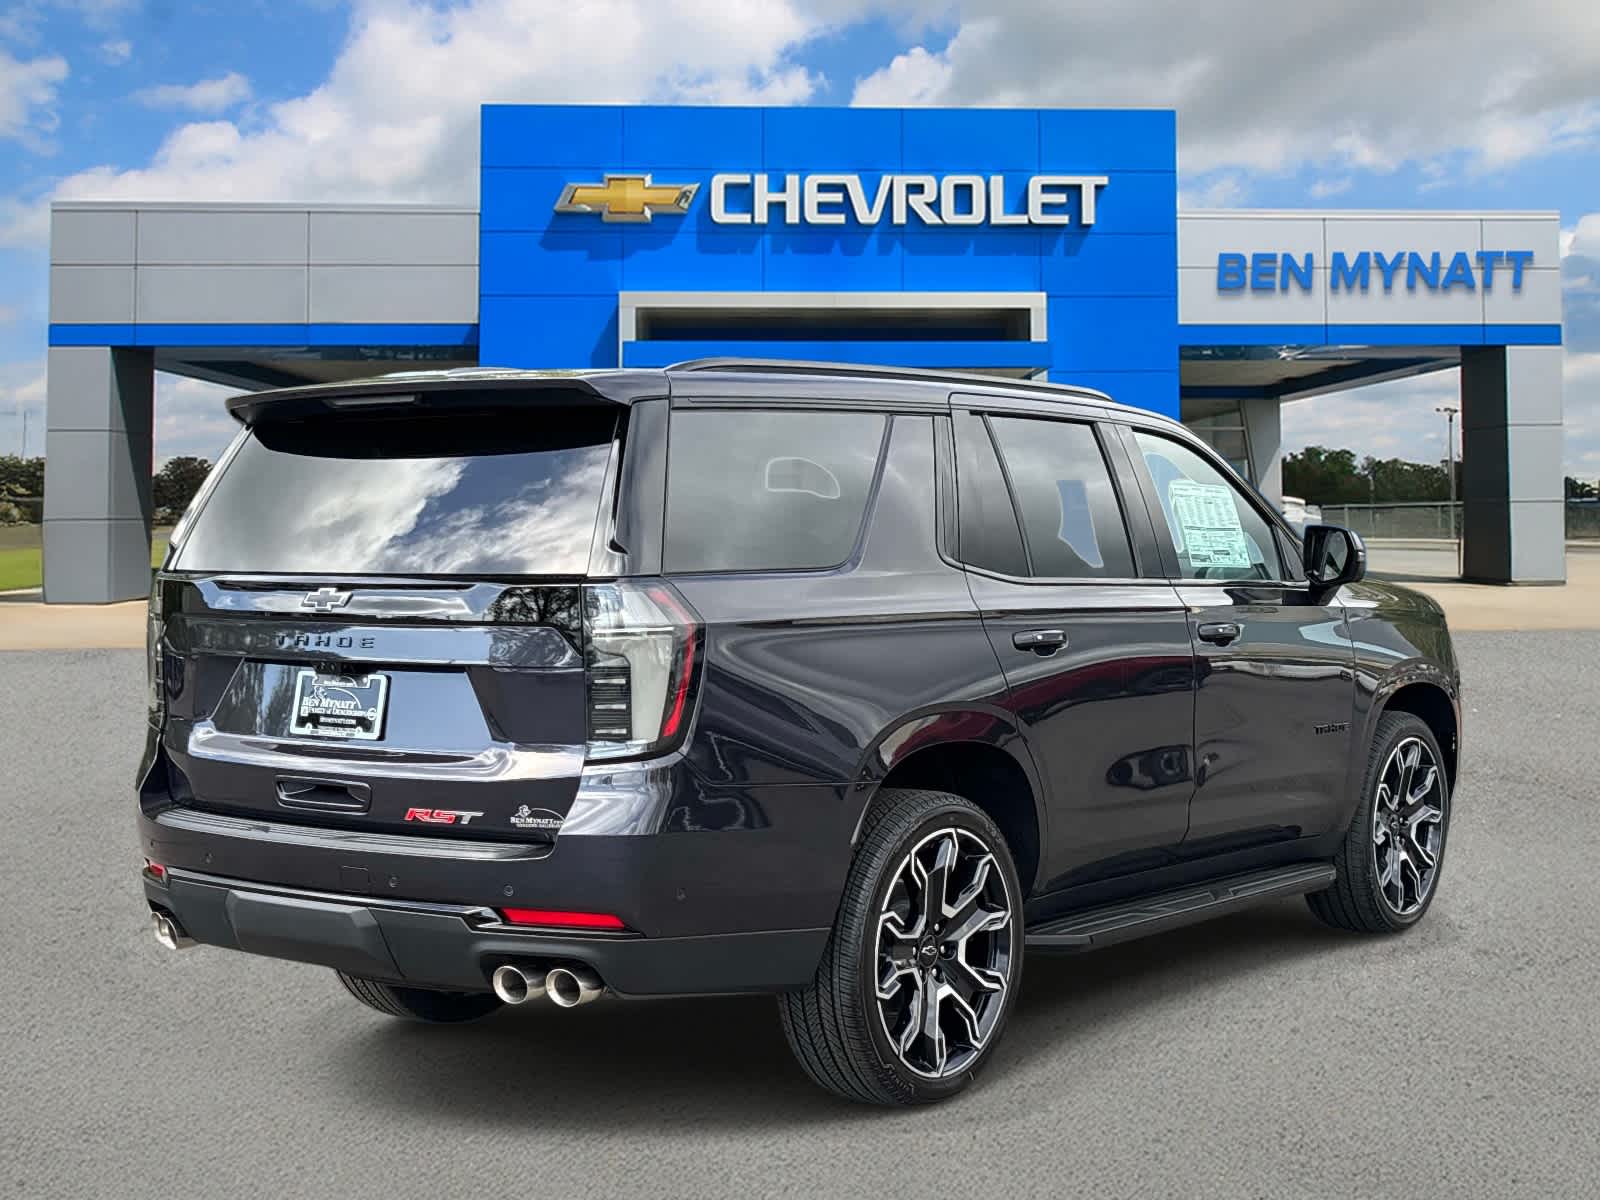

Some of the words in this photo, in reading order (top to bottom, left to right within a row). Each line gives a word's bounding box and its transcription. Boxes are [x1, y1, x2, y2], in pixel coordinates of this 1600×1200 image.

[710, 173, 1109, 225] CHEVROLET
[1217, 252, 1313, 291] BEN
[1330, 250, 1534, 291] MYNATT
[273, 634, 376, 649] TAHOE
[404, 807, 484, 824] RST
